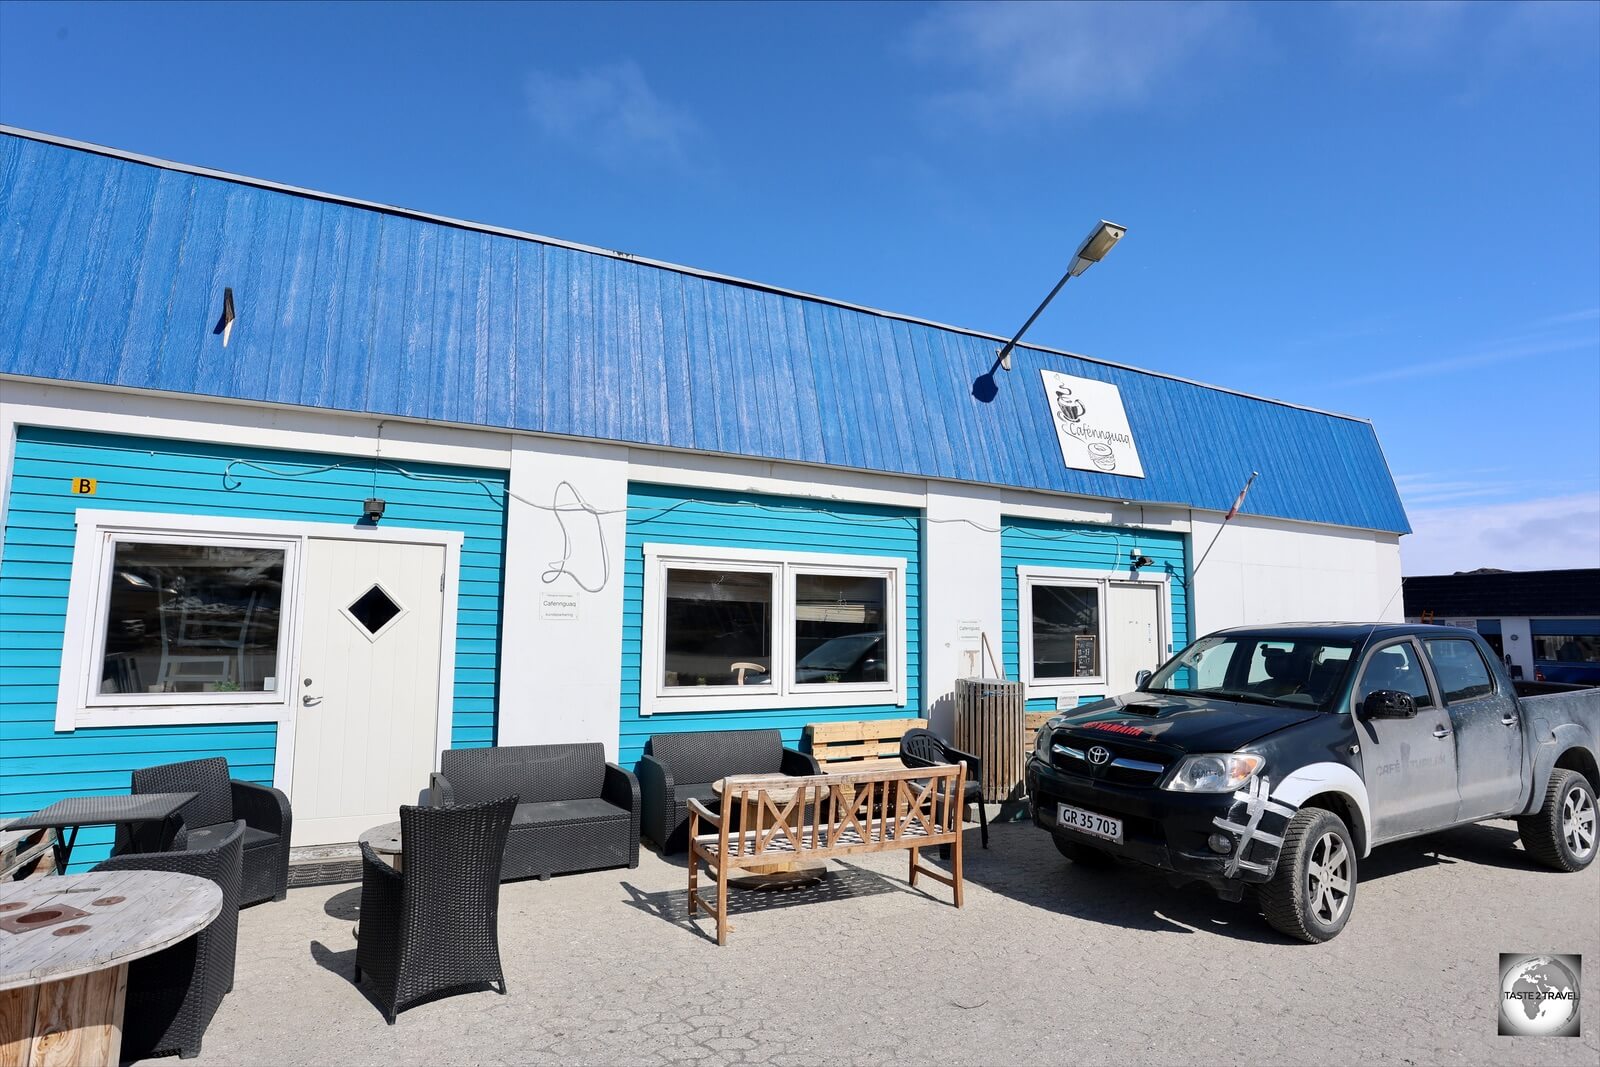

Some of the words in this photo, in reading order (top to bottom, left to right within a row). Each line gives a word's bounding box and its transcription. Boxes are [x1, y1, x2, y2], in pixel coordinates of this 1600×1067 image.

[80, 479, 91, 493] B
[1063, 809, 1077, 824] GR
[1080, 813, 1093, 828] 35
[1097, 817, 1117, 836] 703
